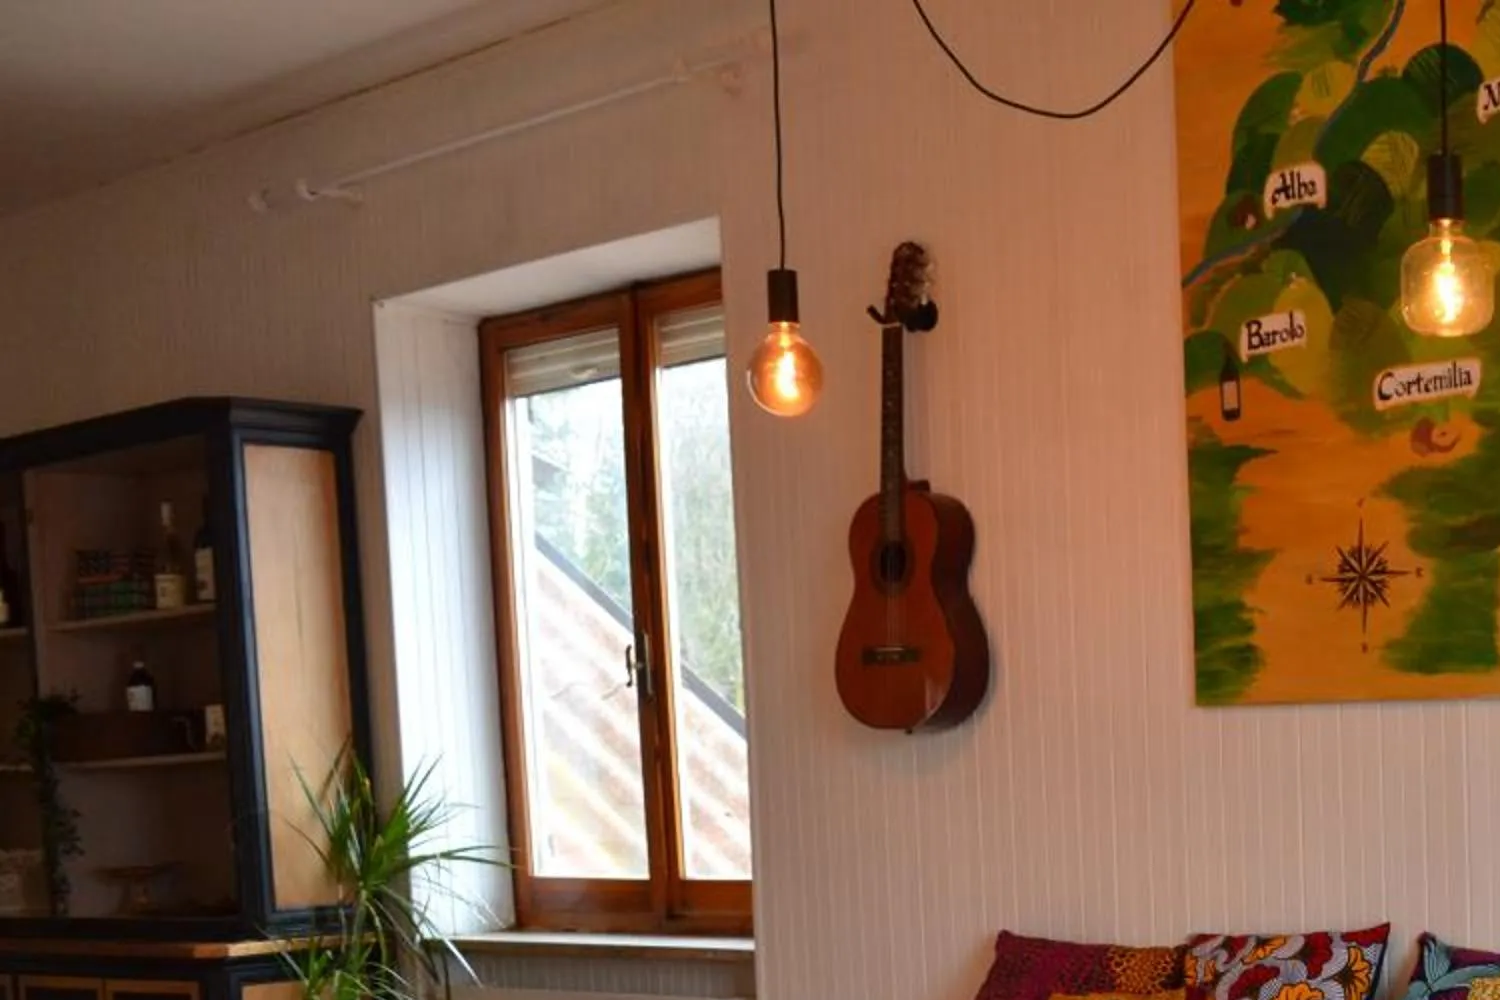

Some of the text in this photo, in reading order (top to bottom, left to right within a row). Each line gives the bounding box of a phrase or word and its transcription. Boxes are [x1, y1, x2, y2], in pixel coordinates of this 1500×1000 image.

[1272, 173, 1317, 203] Alba
[1245, 313, 1305, 351] Barolo
[1377, 364, 1473, 400] Cortemilia
